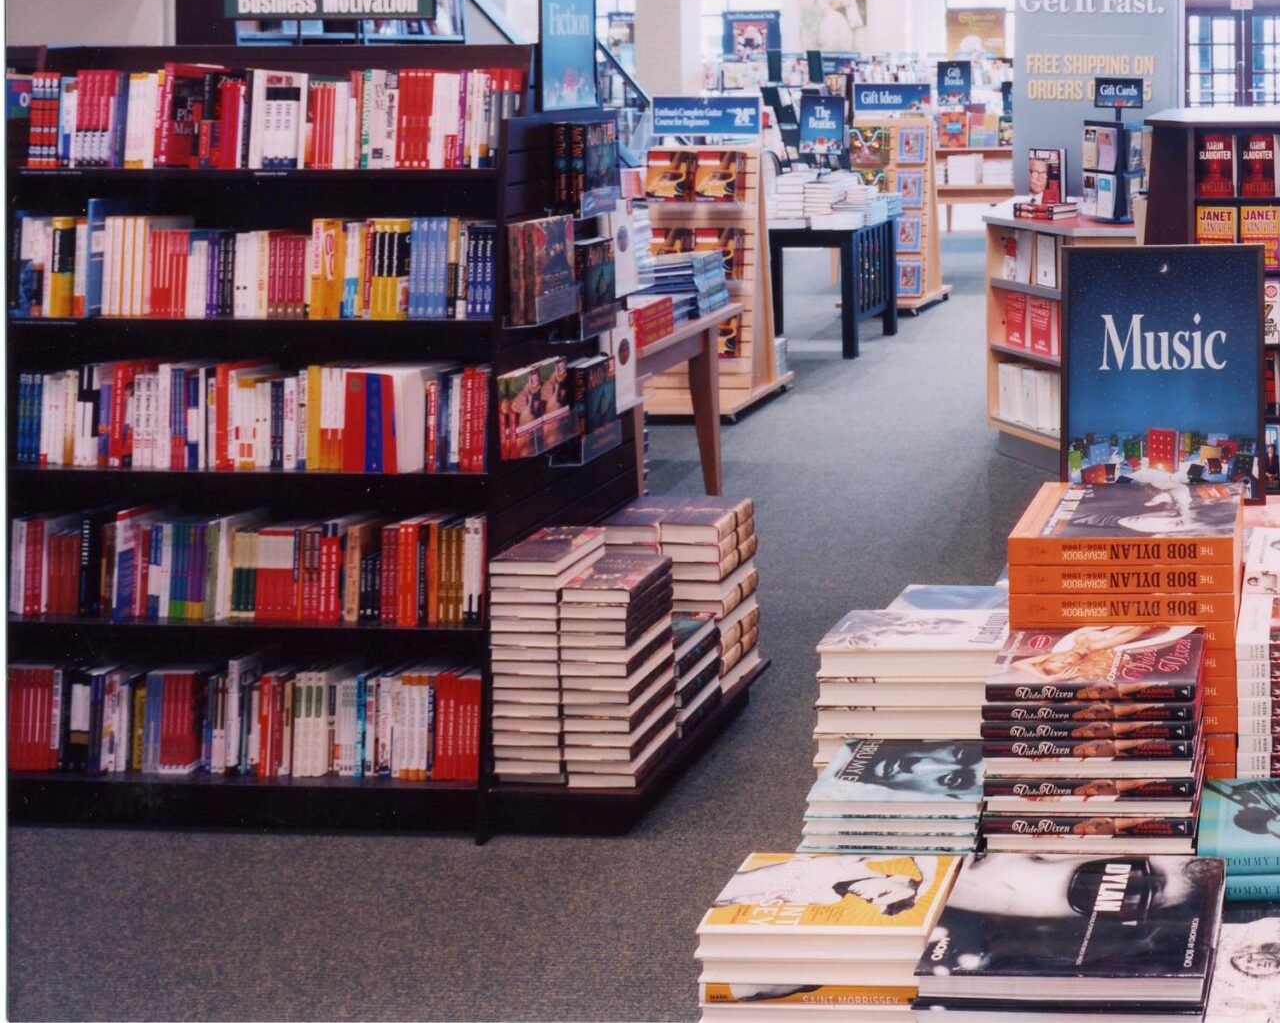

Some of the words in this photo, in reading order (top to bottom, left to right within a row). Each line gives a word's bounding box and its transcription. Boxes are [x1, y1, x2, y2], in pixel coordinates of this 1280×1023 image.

[548, 3, 590, 36] Fiction
[1025, 54, 1060, 75] FREE
[1064, 54, 1130, 75] SHIPPING
[1134, 54, 1155, 75] ON
[1027, 80, 1084, 101] ORDERS
[1099, 84, 1115, 96] Gift
[1116, 85, 1138, 97] Cards
[860, 91, 878, 105] Gift
[880, 91, 903, 105] Ideas
[814, 106, 831, 118] The
[808, 117, 836, 129] Beatles
[1206, 141, 1224, 150] KARIN
[1199, 150, 1232, 160] SLAUGHTER
[1200, 211, 1232, 221] JANET
[1098, 313, 1227, 371] Music
[81, 520, 89, 565] CONFIDENCE
[1061, 551, 1107, 560] SCRAPBOOK
[1109, 544, 1161, 559] DYLAN
[1167, 544, 1198, 559] BOB
[1200, 547, 1214, 556] THE
[1015, 686, 1046, 699] Video
[1041, 685, 1074, 699] Vixen
[1012, 742, 1043, 755] Video
[1038, 741, 1070, 755] Vixen
[845, 759, 867, 774] MY
[1012, 820, 1043, 833] Video
[1038, 819, 1070, 833] Vixen
[1225, 857, 1271, 866] TOMMY
[1094, 863, 1132, 912] DYLAN
[1188, 917, 1200, 942] FOREWORD
[930, 937, 950, 961] MOJO
[1183, 949, 1195, 967] BONO
[802, 996, 833, 1005] SAINT
[838, 996, 900, 1005] MORRISSEY
